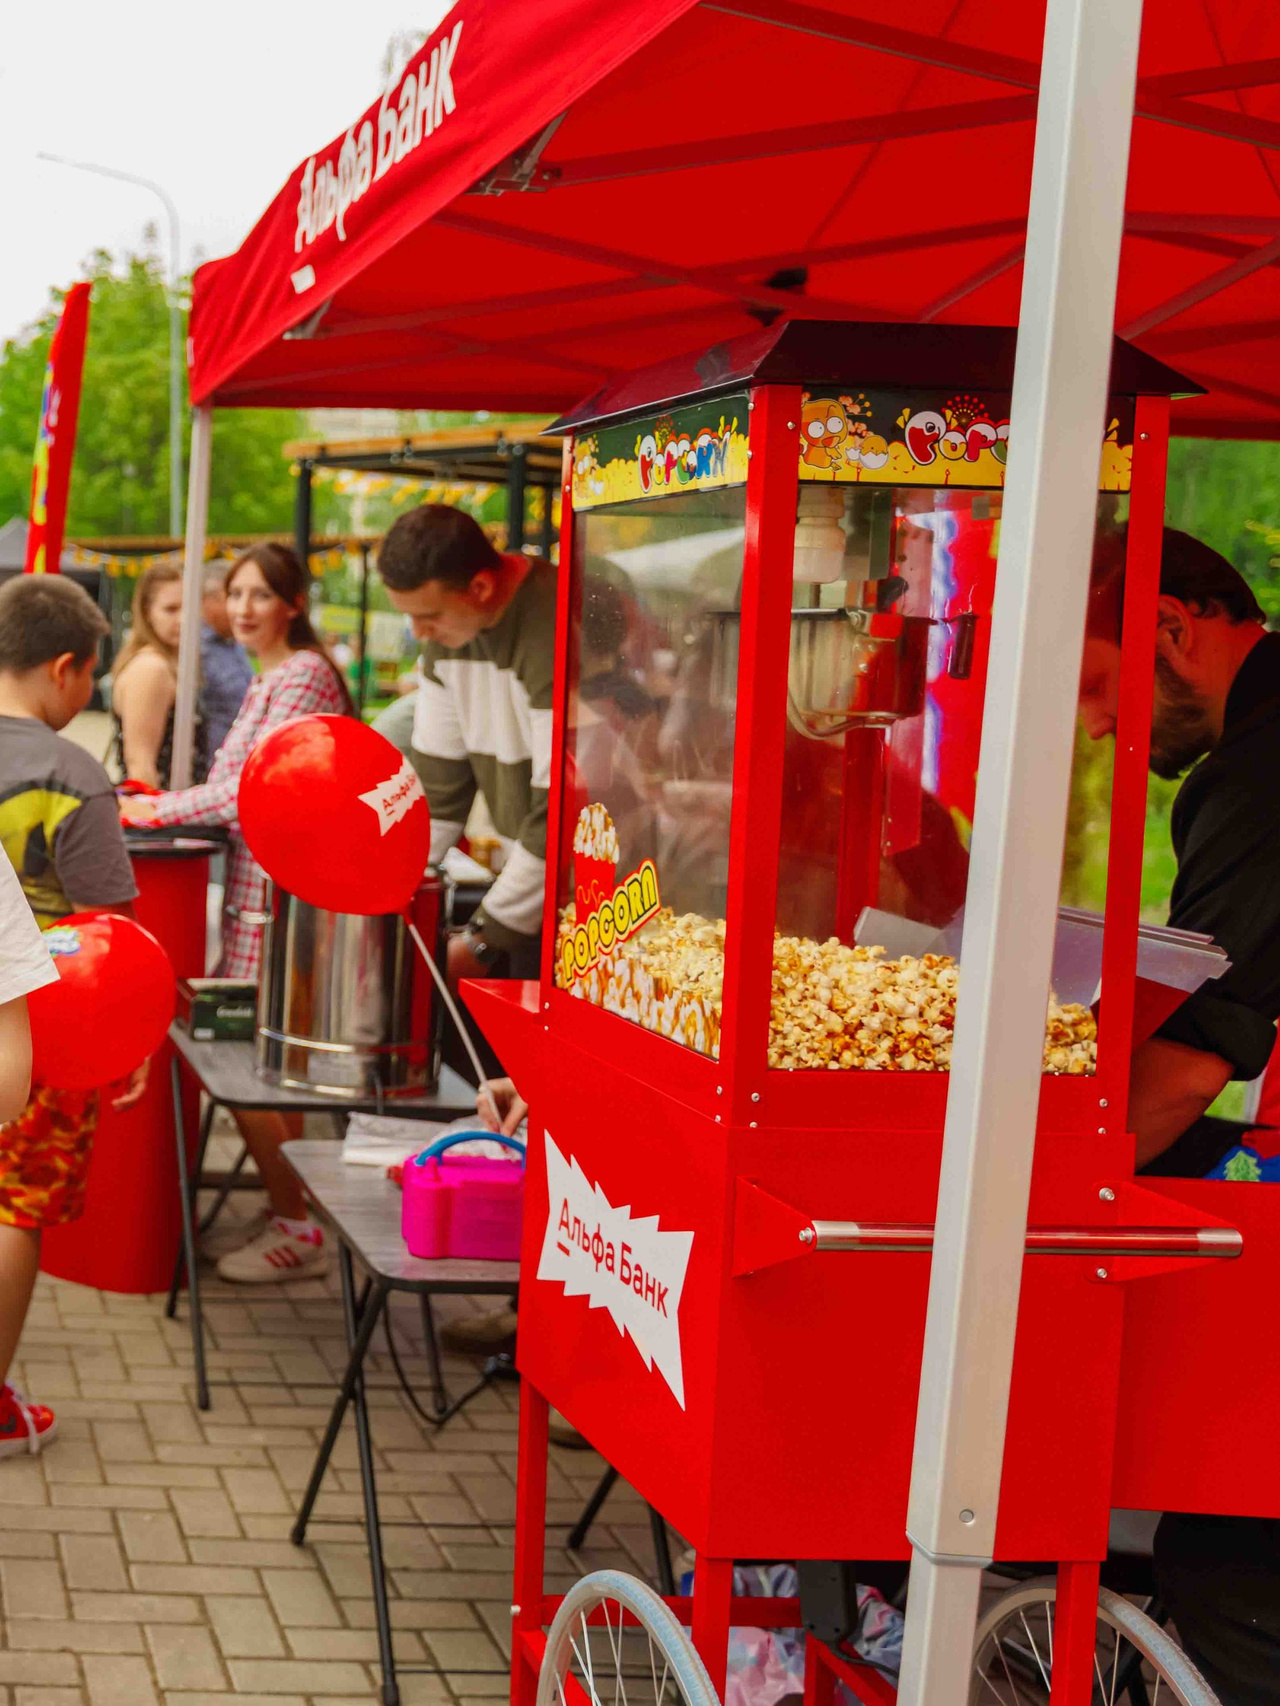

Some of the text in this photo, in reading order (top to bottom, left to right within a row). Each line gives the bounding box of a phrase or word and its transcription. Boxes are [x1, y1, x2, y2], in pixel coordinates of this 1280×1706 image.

[293, 20, 464, 253] Альфа Банк
[562, 864, 658, 983] POPCORN
[558, 1197, 669, 1319] Альфа Банк
